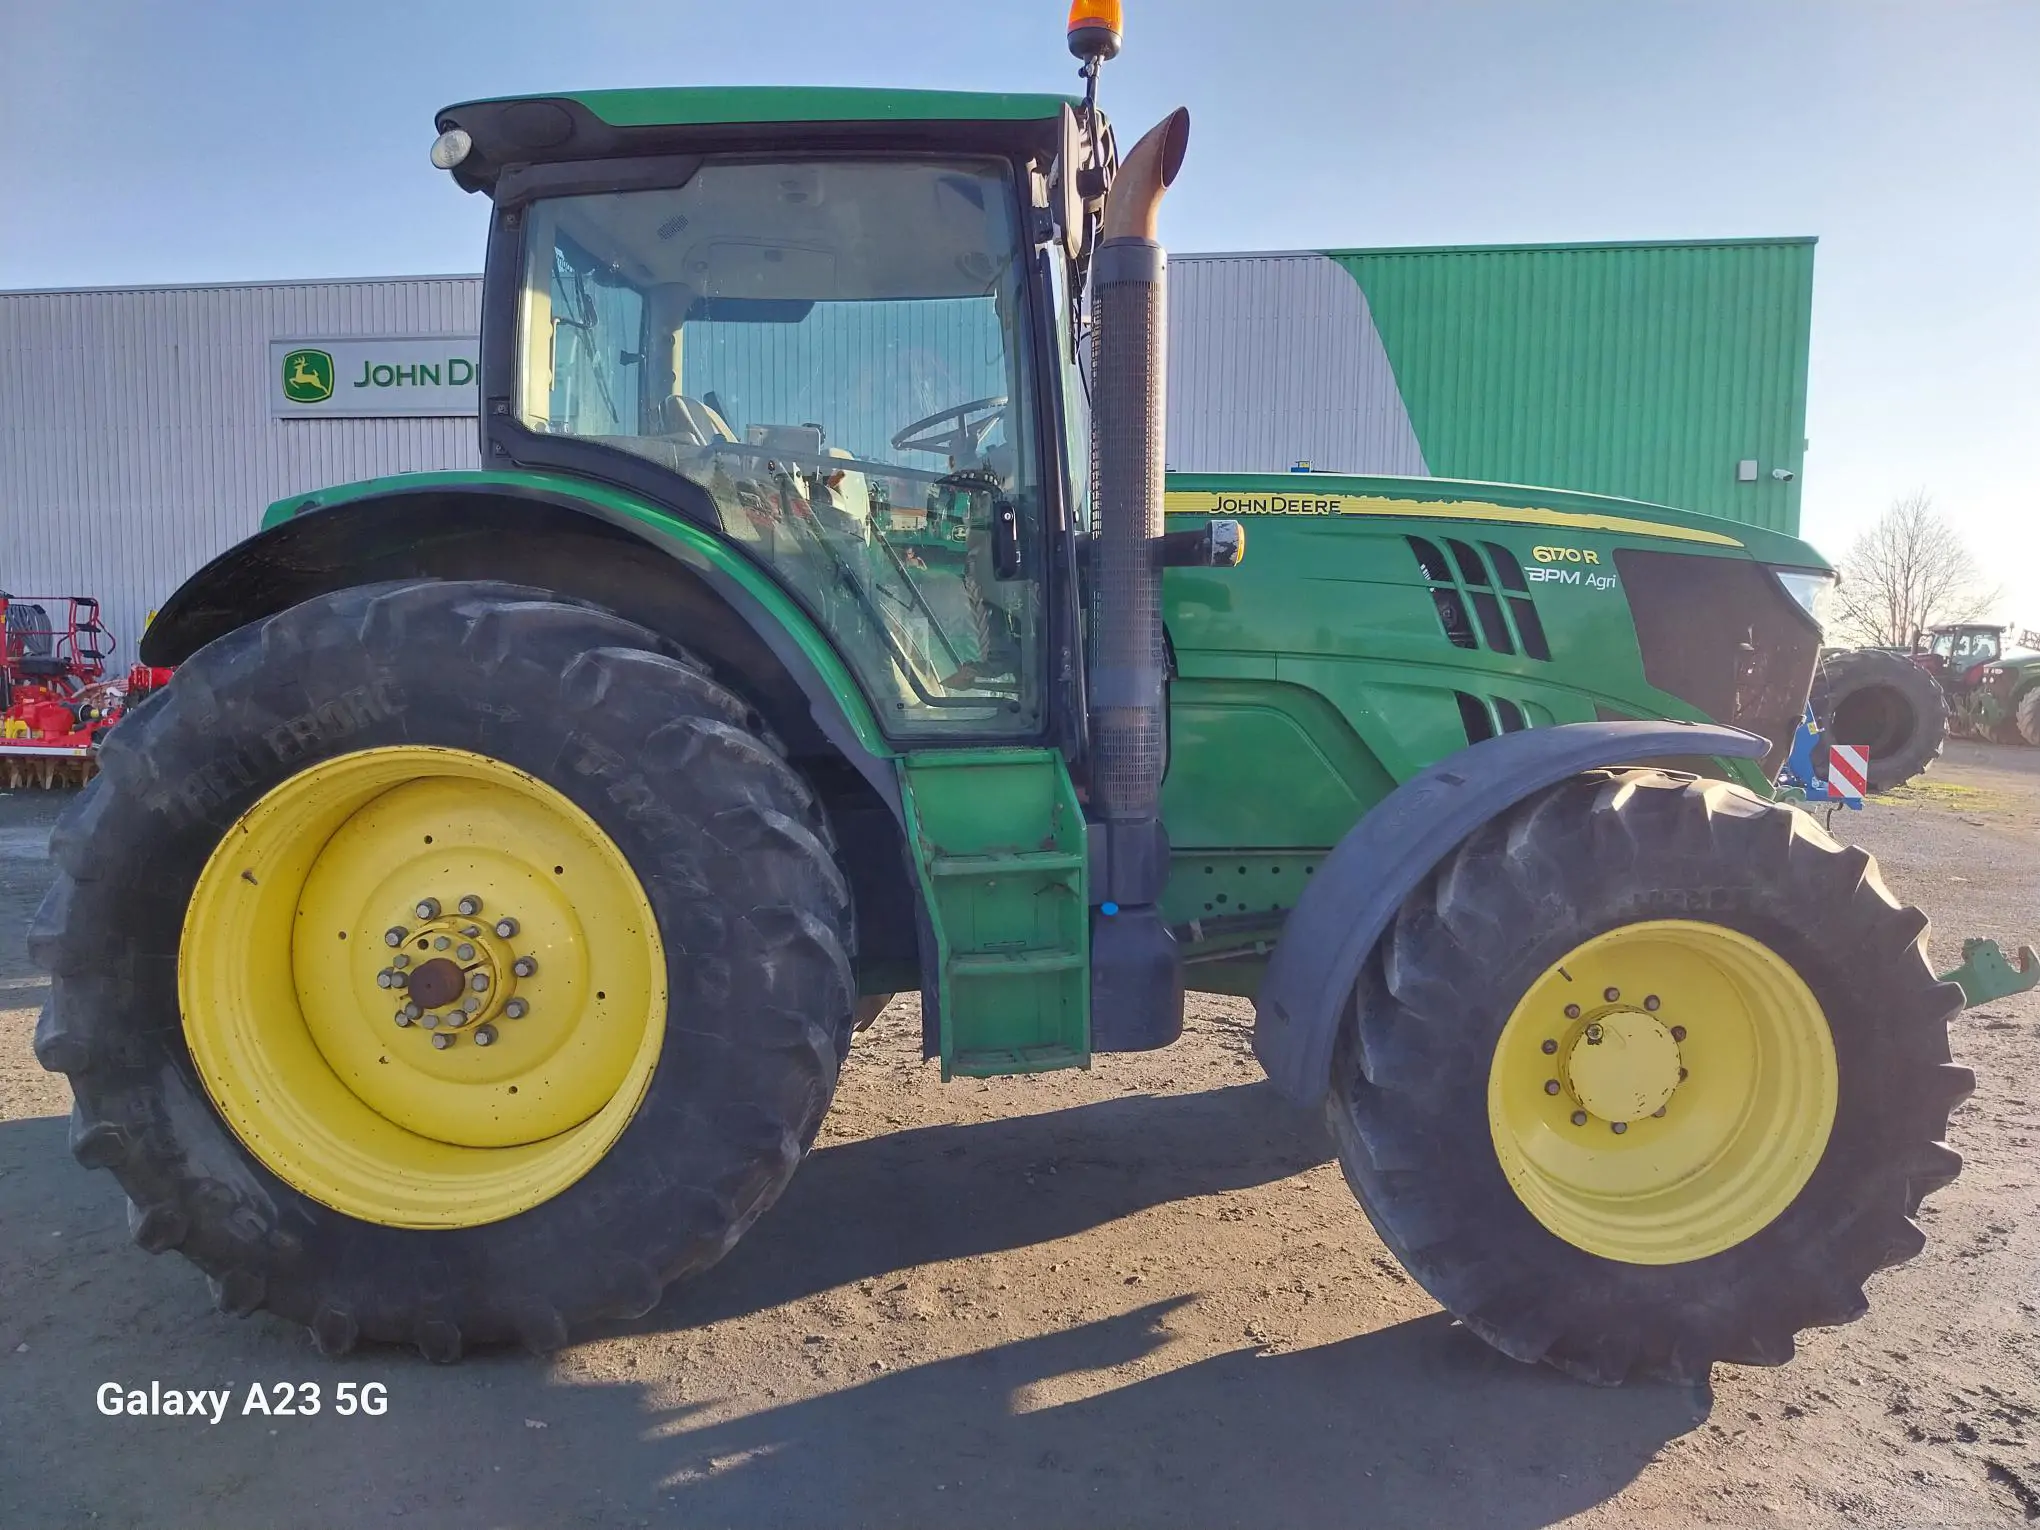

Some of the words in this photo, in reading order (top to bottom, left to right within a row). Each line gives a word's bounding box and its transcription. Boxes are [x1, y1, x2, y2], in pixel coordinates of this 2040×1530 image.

[353, 360, 441, 388] JOHN
[448, 358, 479, 387] D
[1210, 496, 1267, 512] JOHN
[1271, 496, 1341, 513] DEERE
[1524, 566, 1580, 585] BPM
[1585, 572, 1617, 591] Agri
